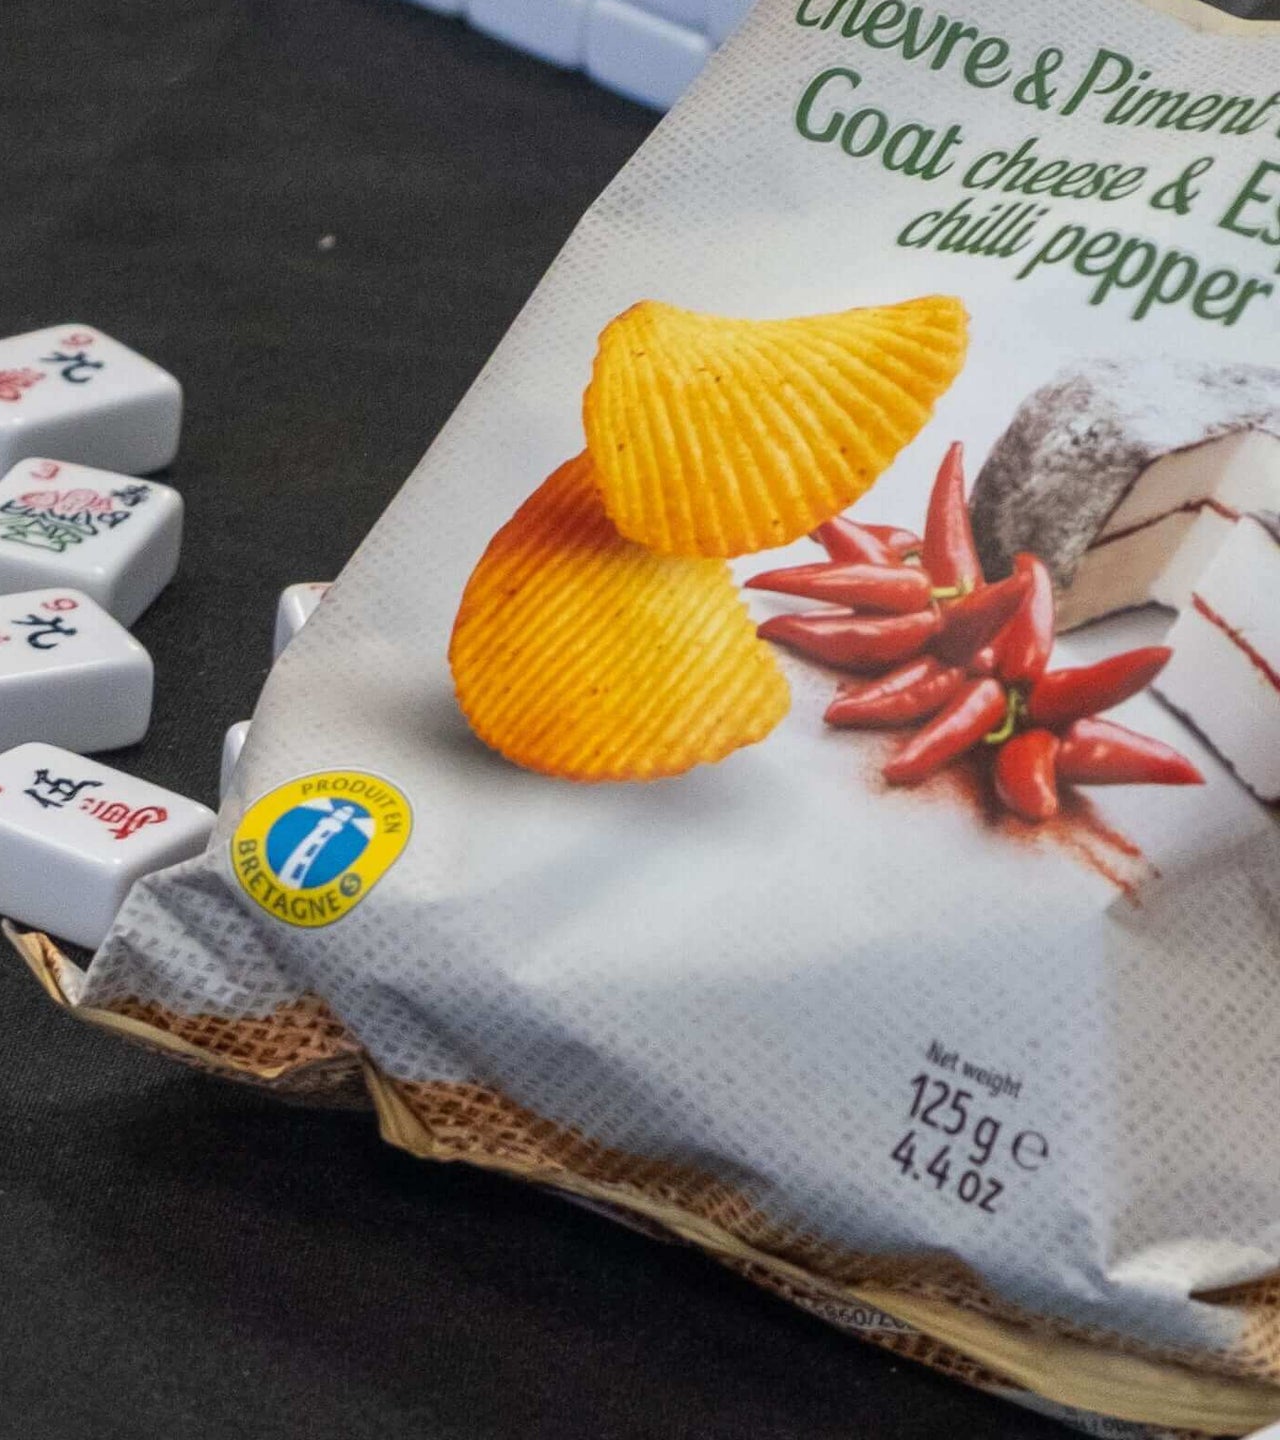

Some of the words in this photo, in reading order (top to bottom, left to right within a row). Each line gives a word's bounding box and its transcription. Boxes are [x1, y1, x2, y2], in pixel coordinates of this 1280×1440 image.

[1013, 45, 1064, 111] &
[796, 67, 962, 181] Goat
[961, 137, 1147, 201] cheese
[1148, 157, 1214, 216] &
[897, 197, 1049, 259] chilli
[1015, 219, 1273, 327] pepper
[301, 777, 397, 809] PRODUIT
[383, 812, 403, 834] EN
[240, 838, 341, 920] BRETAGNE
[926, 1039, 960, 1072] Net
[962, 1060, 1024, 1099] weight
[909, 1072, 974, 1136] 125
[968, 1115, 1002, 1166] g
[891, 1130, 951, 1191] 4.4
[958, 1169, 1005, 1215] oz
